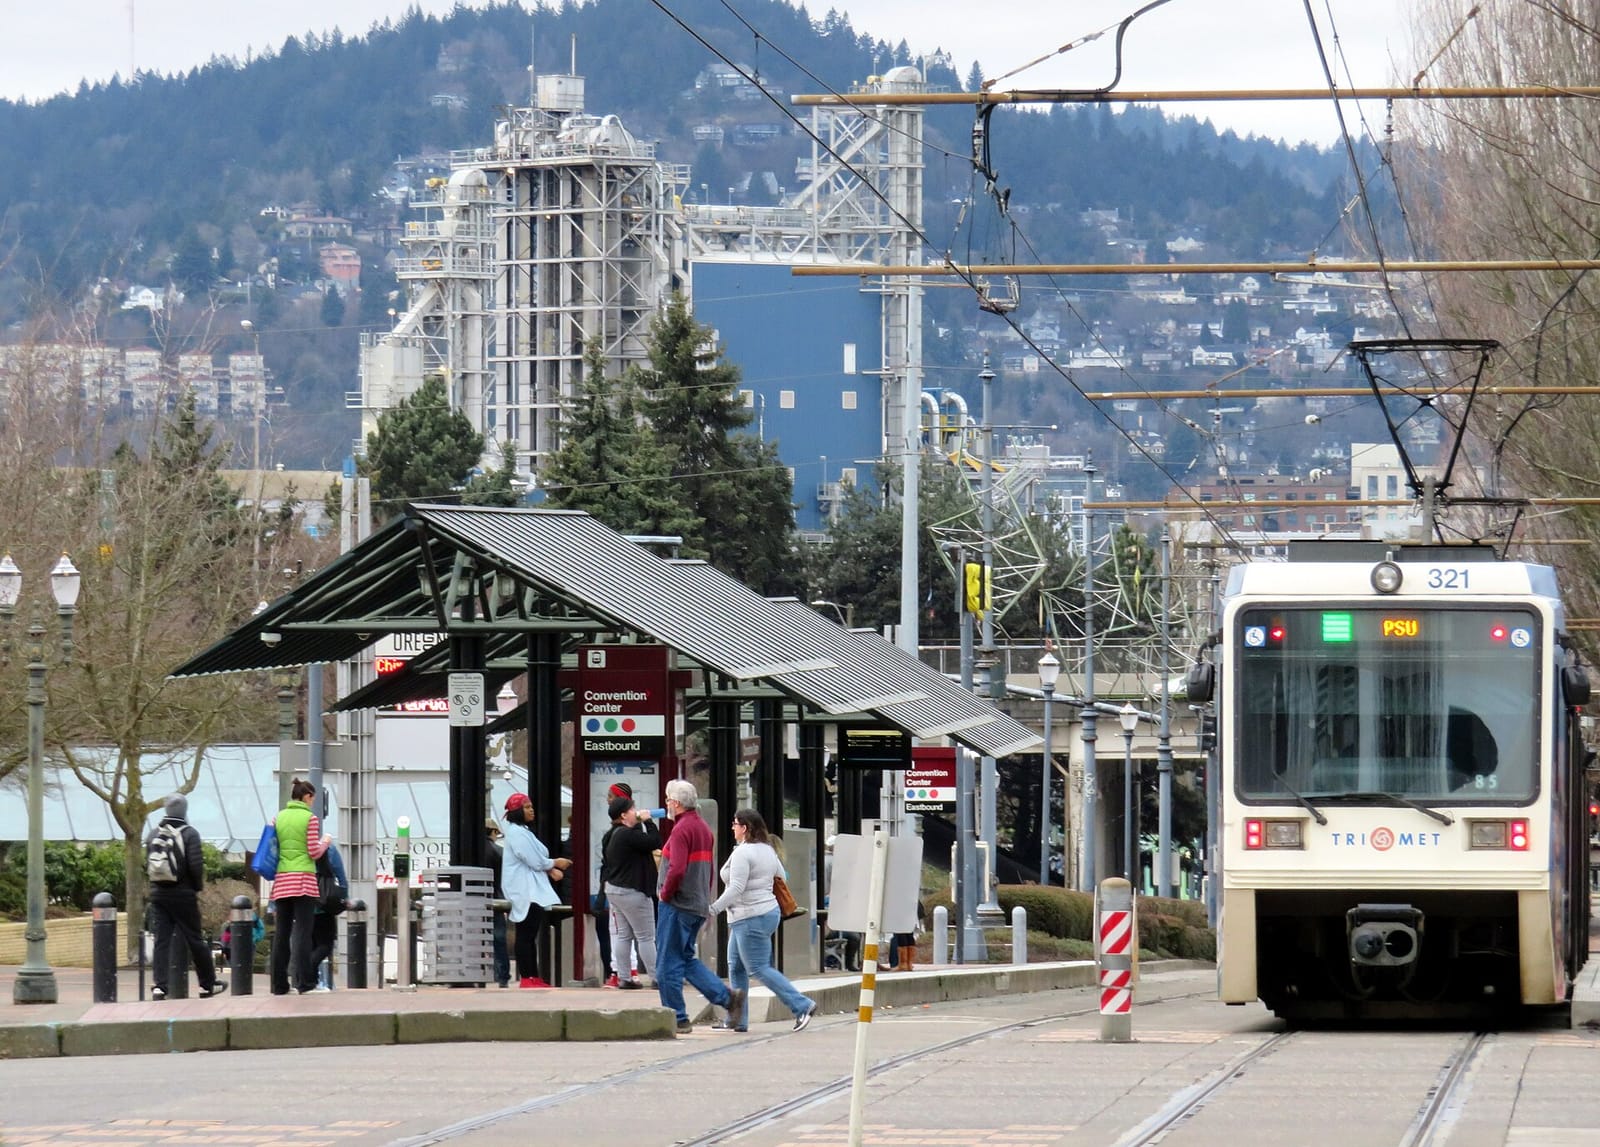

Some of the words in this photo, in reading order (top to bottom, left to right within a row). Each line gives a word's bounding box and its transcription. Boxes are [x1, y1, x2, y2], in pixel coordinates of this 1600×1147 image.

[1428, 568, 1470, 589] 321
[1383, 619, 1418, 637] PSU
[584, 690, 647, 701] Convention
[584, 702, 622, 713] Center
[584, 740, 641, 751] Eastbound
[906, 769, 948, 777] Convention
[906, 803, 943, 811] Eastbound
[1332, 833, 1365, 846] TRI
[1399, 833, 1441, 846] MET
[376, 841, 450, 856] SEAOOD
